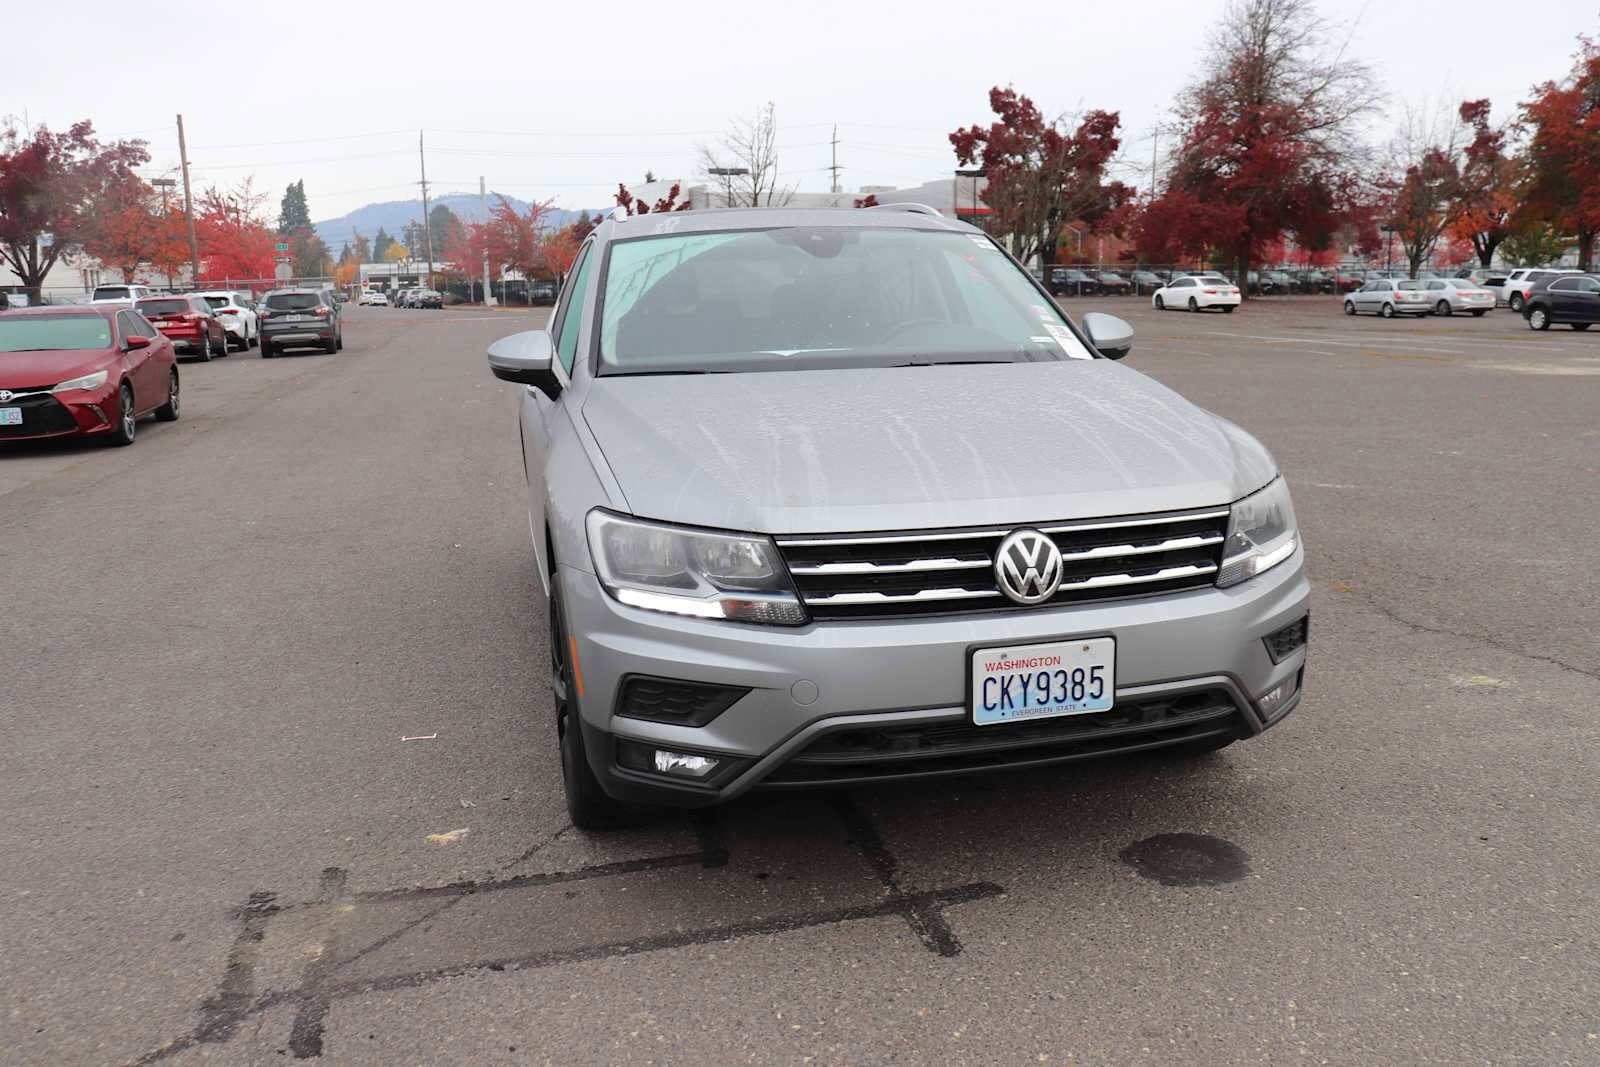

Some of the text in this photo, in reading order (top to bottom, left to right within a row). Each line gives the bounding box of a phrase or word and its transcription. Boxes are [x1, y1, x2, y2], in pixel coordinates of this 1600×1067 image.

[985, 656, 1061, 672] WASHINGTON
[983, 665, 1104, 711] CKY9385
[1011, 703, 1077, 718] EVERGREEN STATE
